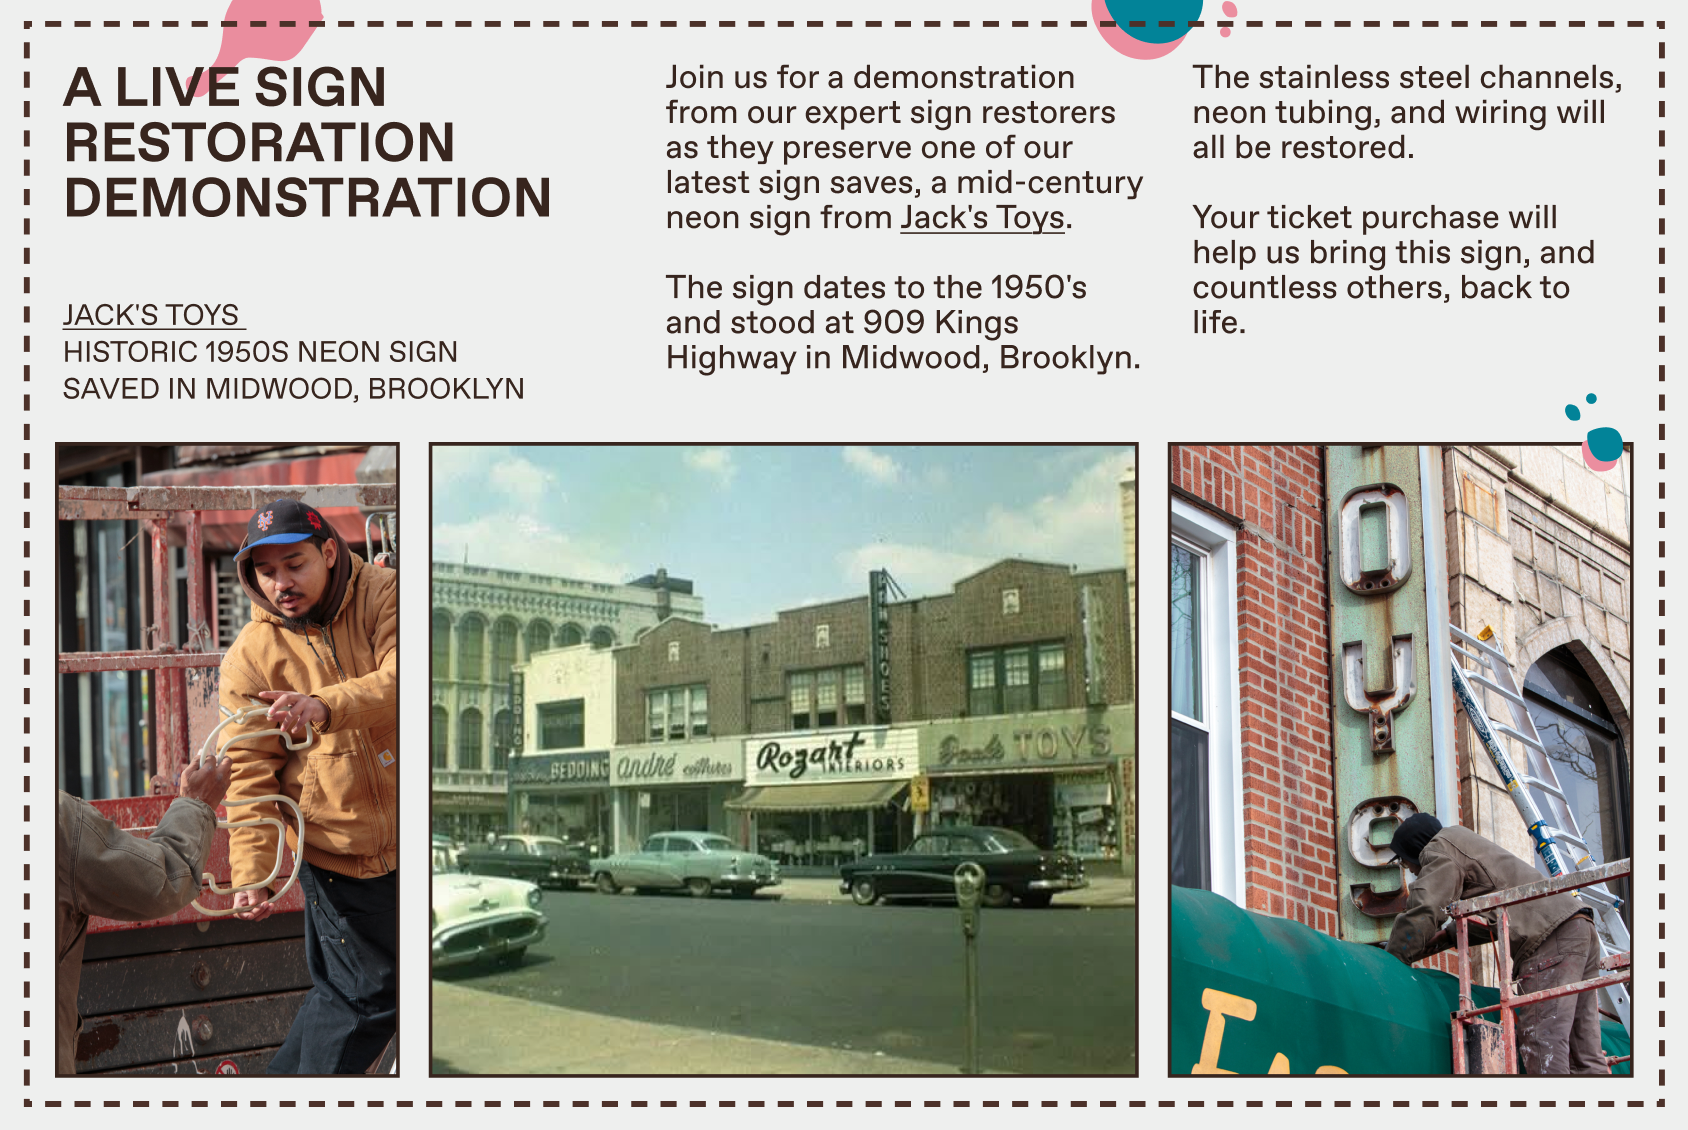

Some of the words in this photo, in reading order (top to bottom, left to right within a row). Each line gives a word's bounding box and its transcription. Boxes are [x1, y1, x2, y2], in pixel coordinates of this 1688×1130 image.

[879, 627, 890, 711] SHOES
[1338, 446, 1420, 918] OYS
[756, 731, 866, 779] Rozart
[1012, 724, 1111, 763] TOYS
[550, 759, 610, 780] BEDDING
[822, 757, 905, 774] INTERIORS
